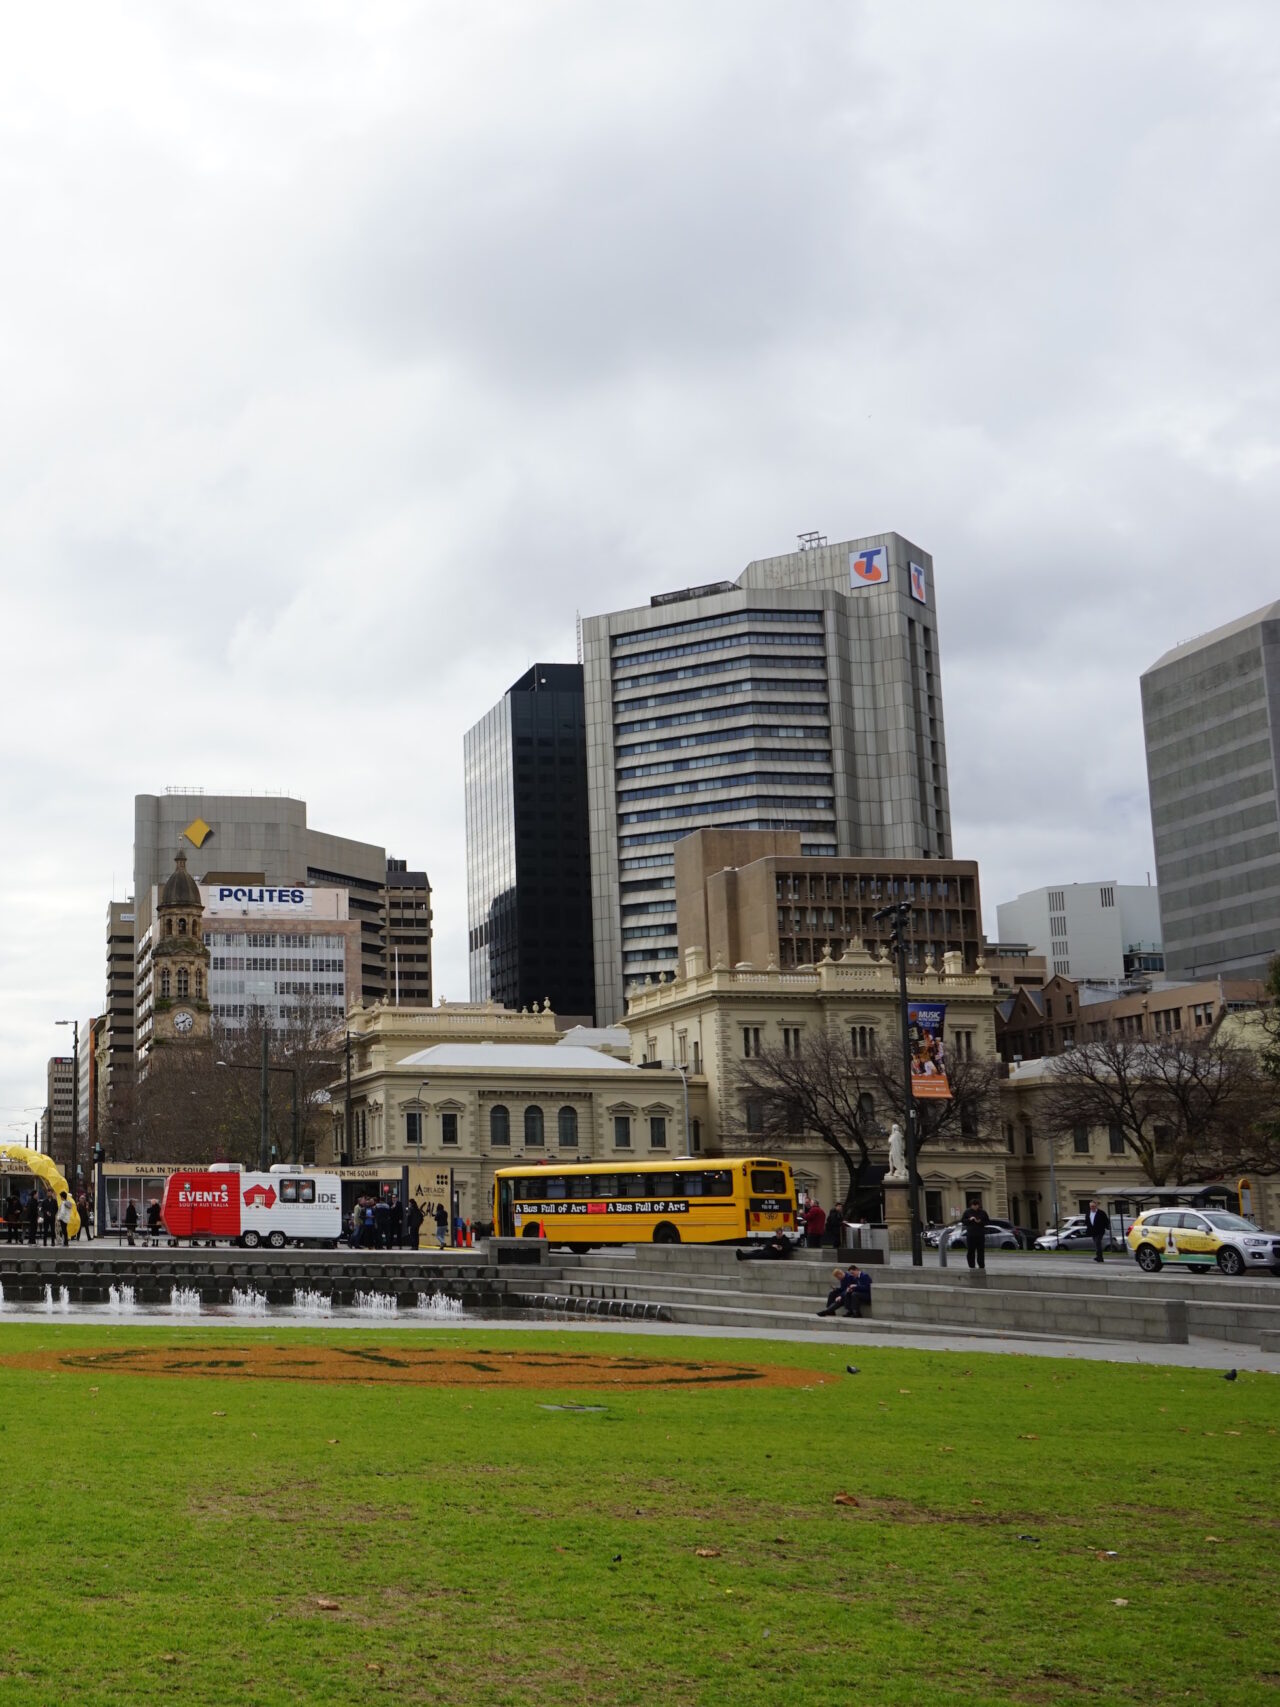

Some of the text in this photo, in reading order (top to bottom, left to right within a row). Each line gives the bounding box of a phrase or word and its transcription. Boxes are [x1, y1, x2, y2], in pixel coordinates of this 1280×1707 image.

[219, 888, 305, 904] POLITES
[918, 1010, 941, 1019] MUSIC
[135, 1166, 154, 1174] SALA
[357, 1170, 378, 1178] SQUARE
[178, 1191, 229, 1202] EVENTS
[515, 1204, 522, 1213] A
[523, 1204, 538, 1213] Bus
[541, 1204, 556, 1213] Full
[558, 1203, 567, 1213] of
[570, 1203, 587, 1213] Art
[607, 1203, 614, 1212] A
[616, 1203, 633, 1212] Bus
[635, 1202, 651, 1212] Full
[653, 1202, 665, 1211] of
[667, 1202, 686, 1211] Art
